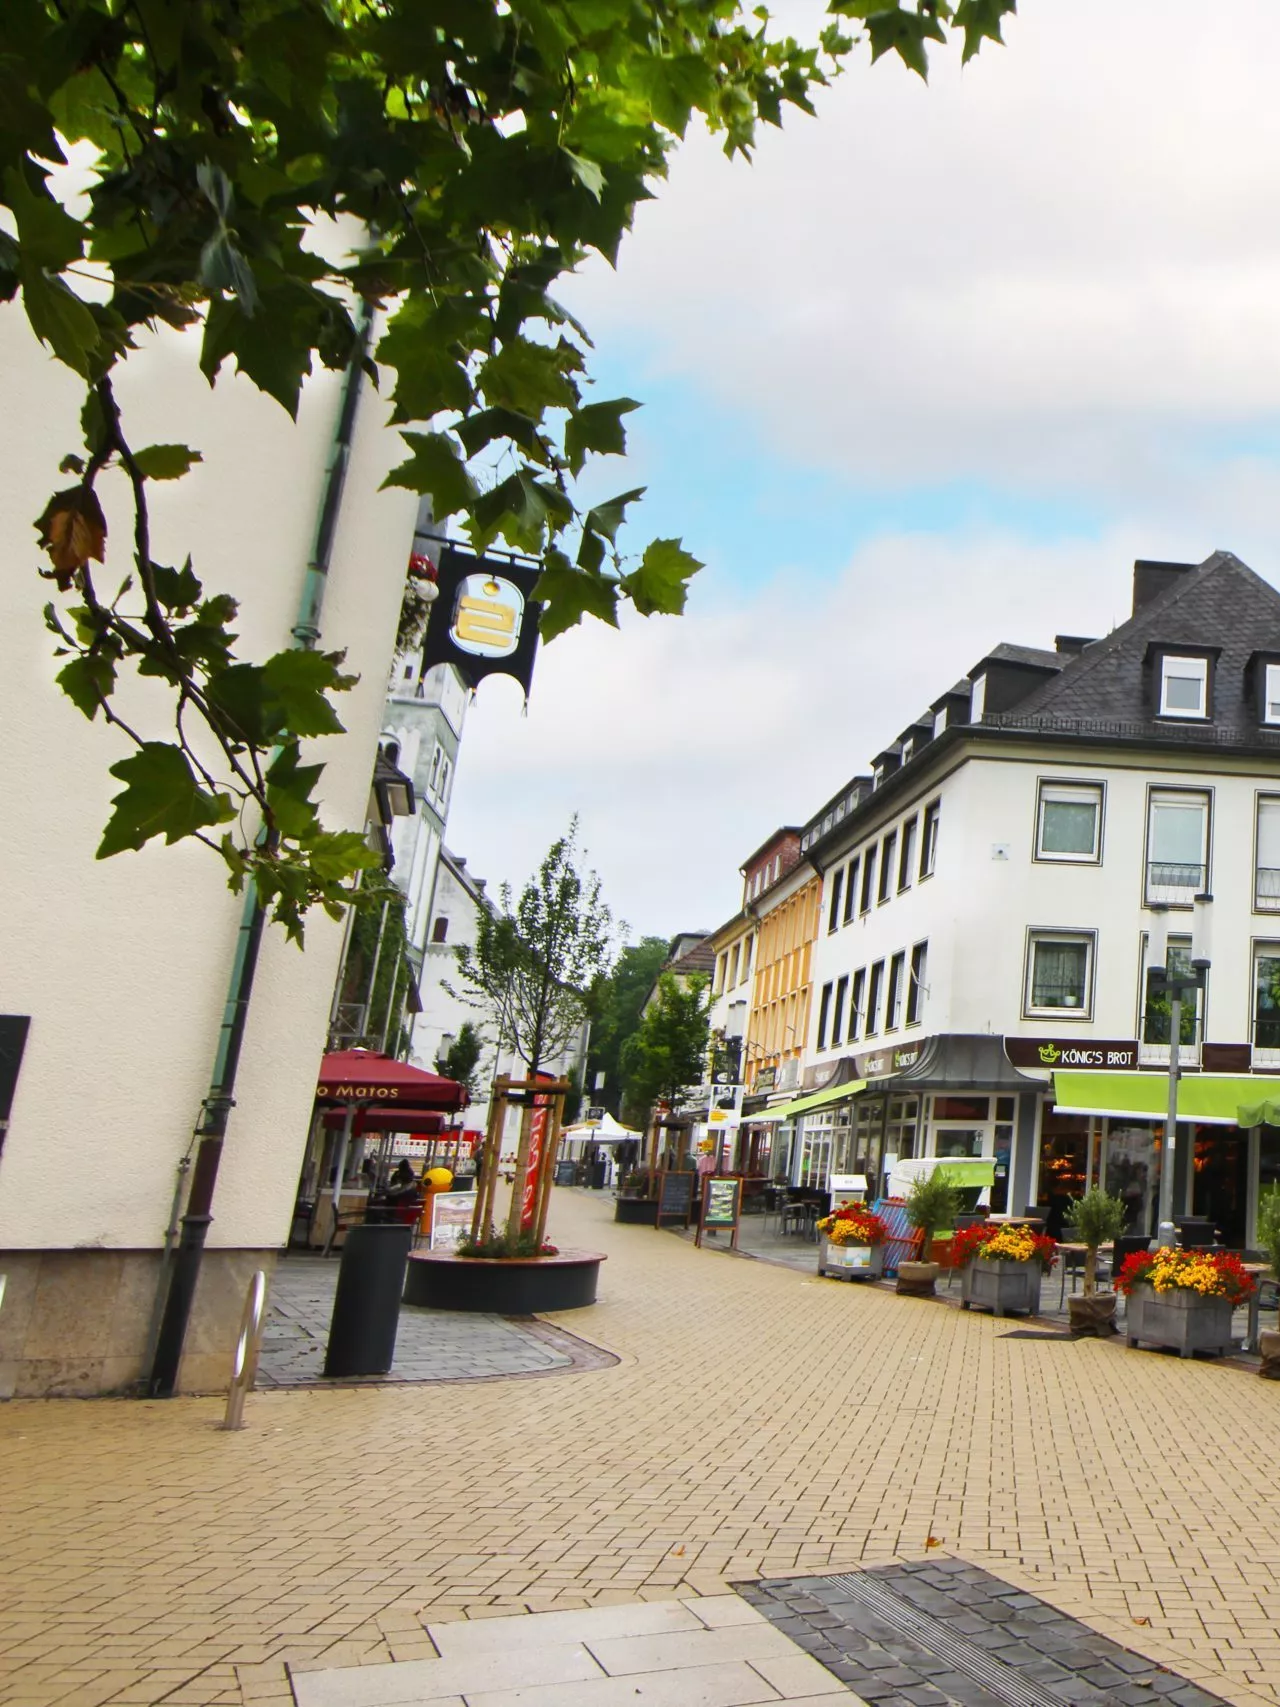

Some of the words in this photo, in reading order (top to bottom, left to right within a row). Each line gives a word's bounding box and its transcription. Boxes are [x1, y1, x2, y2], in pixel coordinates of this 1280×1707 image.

[1061, 1049, 1103, 1064] KÖNIG'S
[1107, 1052, 1133, 1064] BROT
[336, 1085, 398, 1098] Matos
